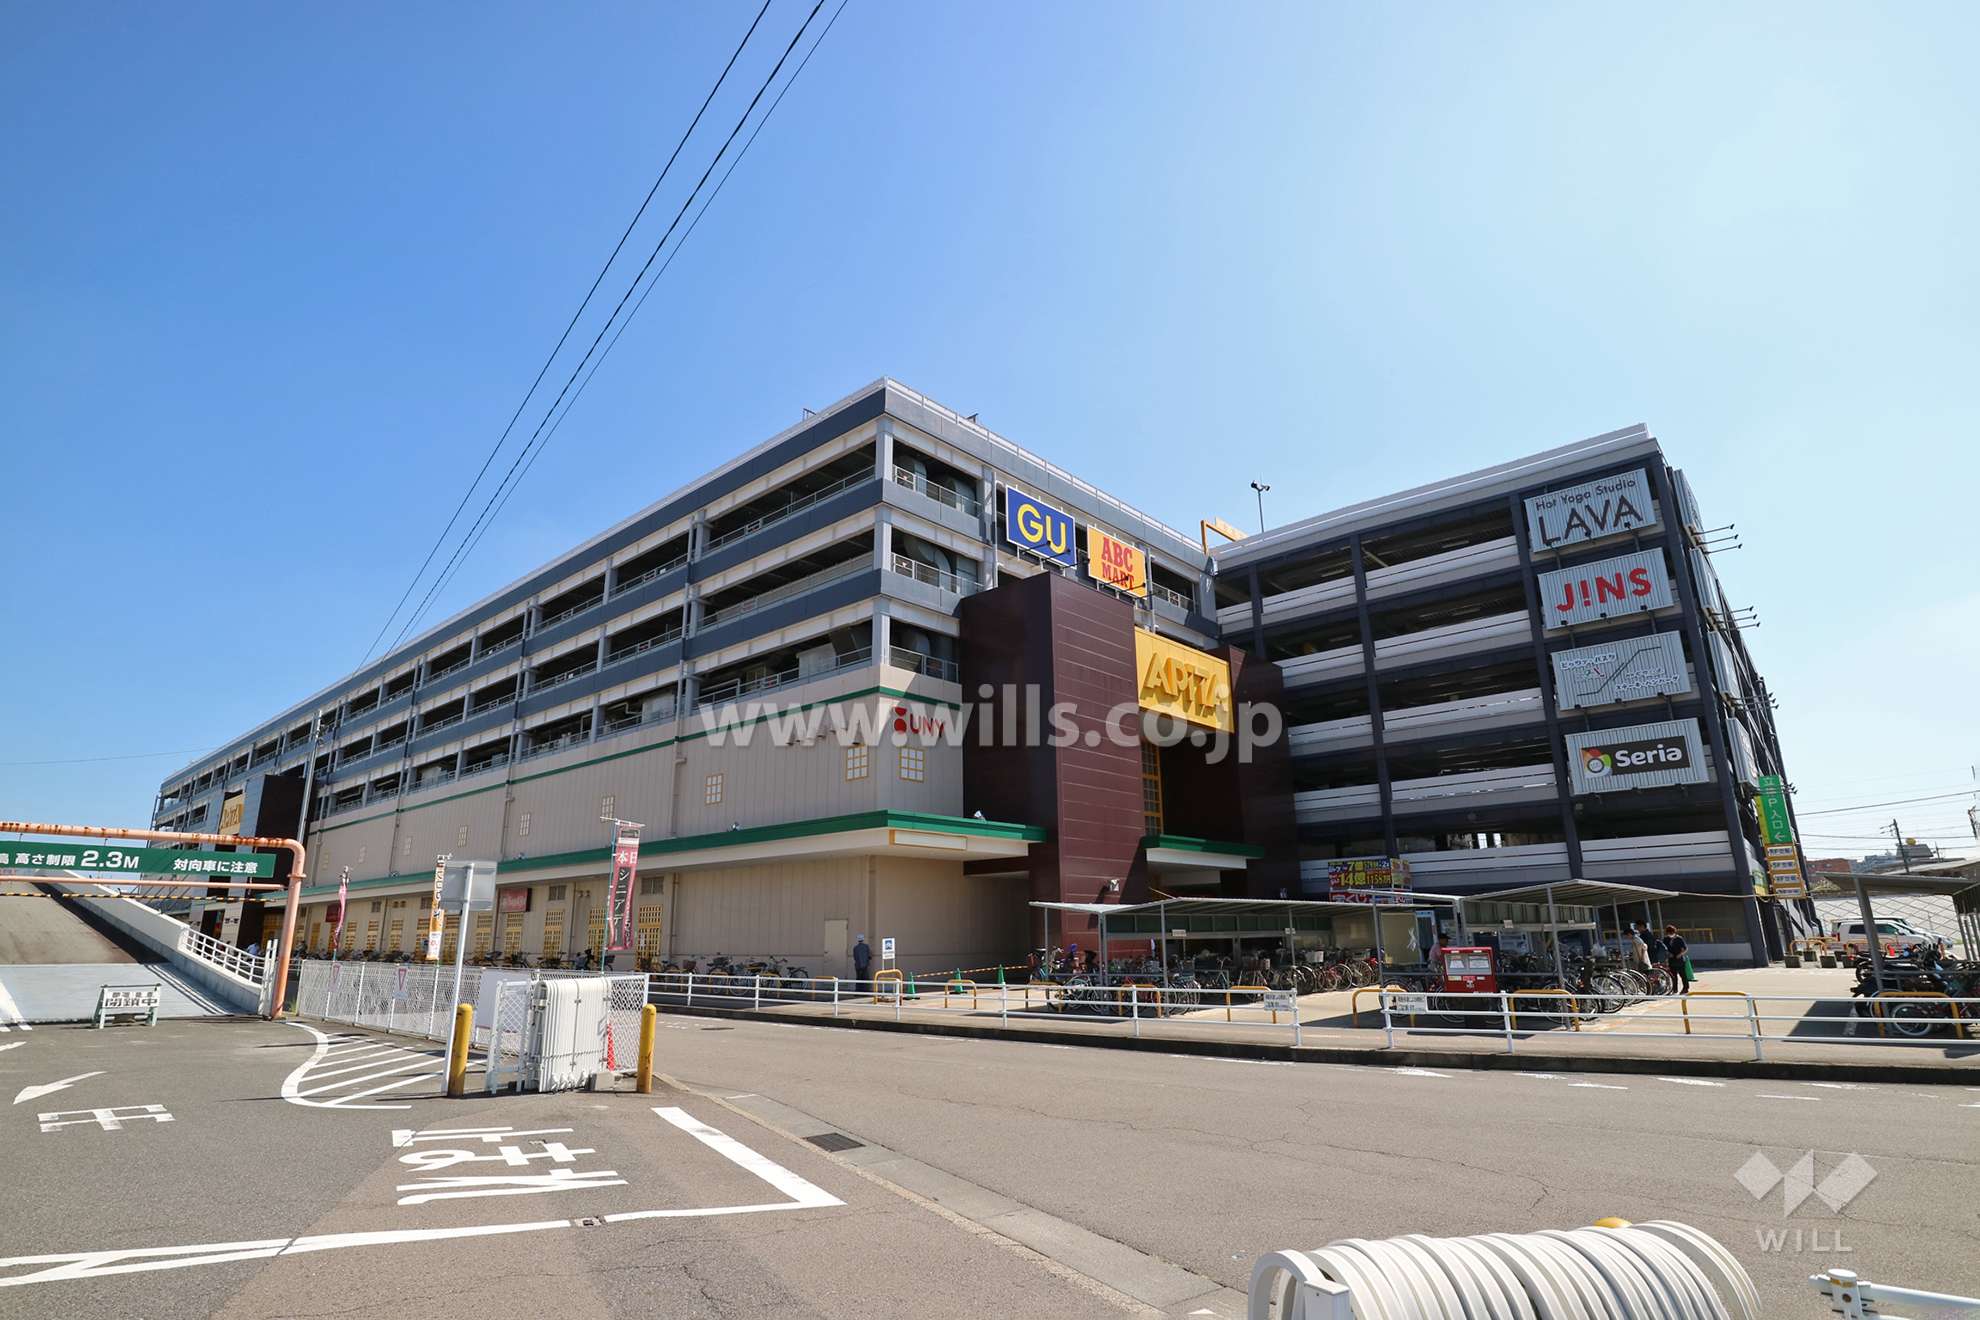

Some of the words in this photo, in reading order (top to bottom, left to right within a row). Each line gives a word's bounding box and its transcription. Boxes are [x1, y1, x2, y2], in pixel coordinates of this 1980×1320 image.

[1561, 492, 1591, 504] Yoga
[1595, 480, 1636, 496] Studio
[1017, 503, 1067, 554] GU
[1539, 495, 1643, 545] LAVA
[1102, 537, 1133, 572] ABC
[1102, 563, 1134, 590] MART
[910, 714, 944, 737] UNY
[1615, 744, 1682, 767] Seria
[15, 853, 76, 866] 高さ制限
[80, 850, 140, 869] 2.3M
[172, 858, 258, 873] 対向車に注意
[616, 850, 637, 864] 本日
[614, 868, 630, 942] シニアデー
